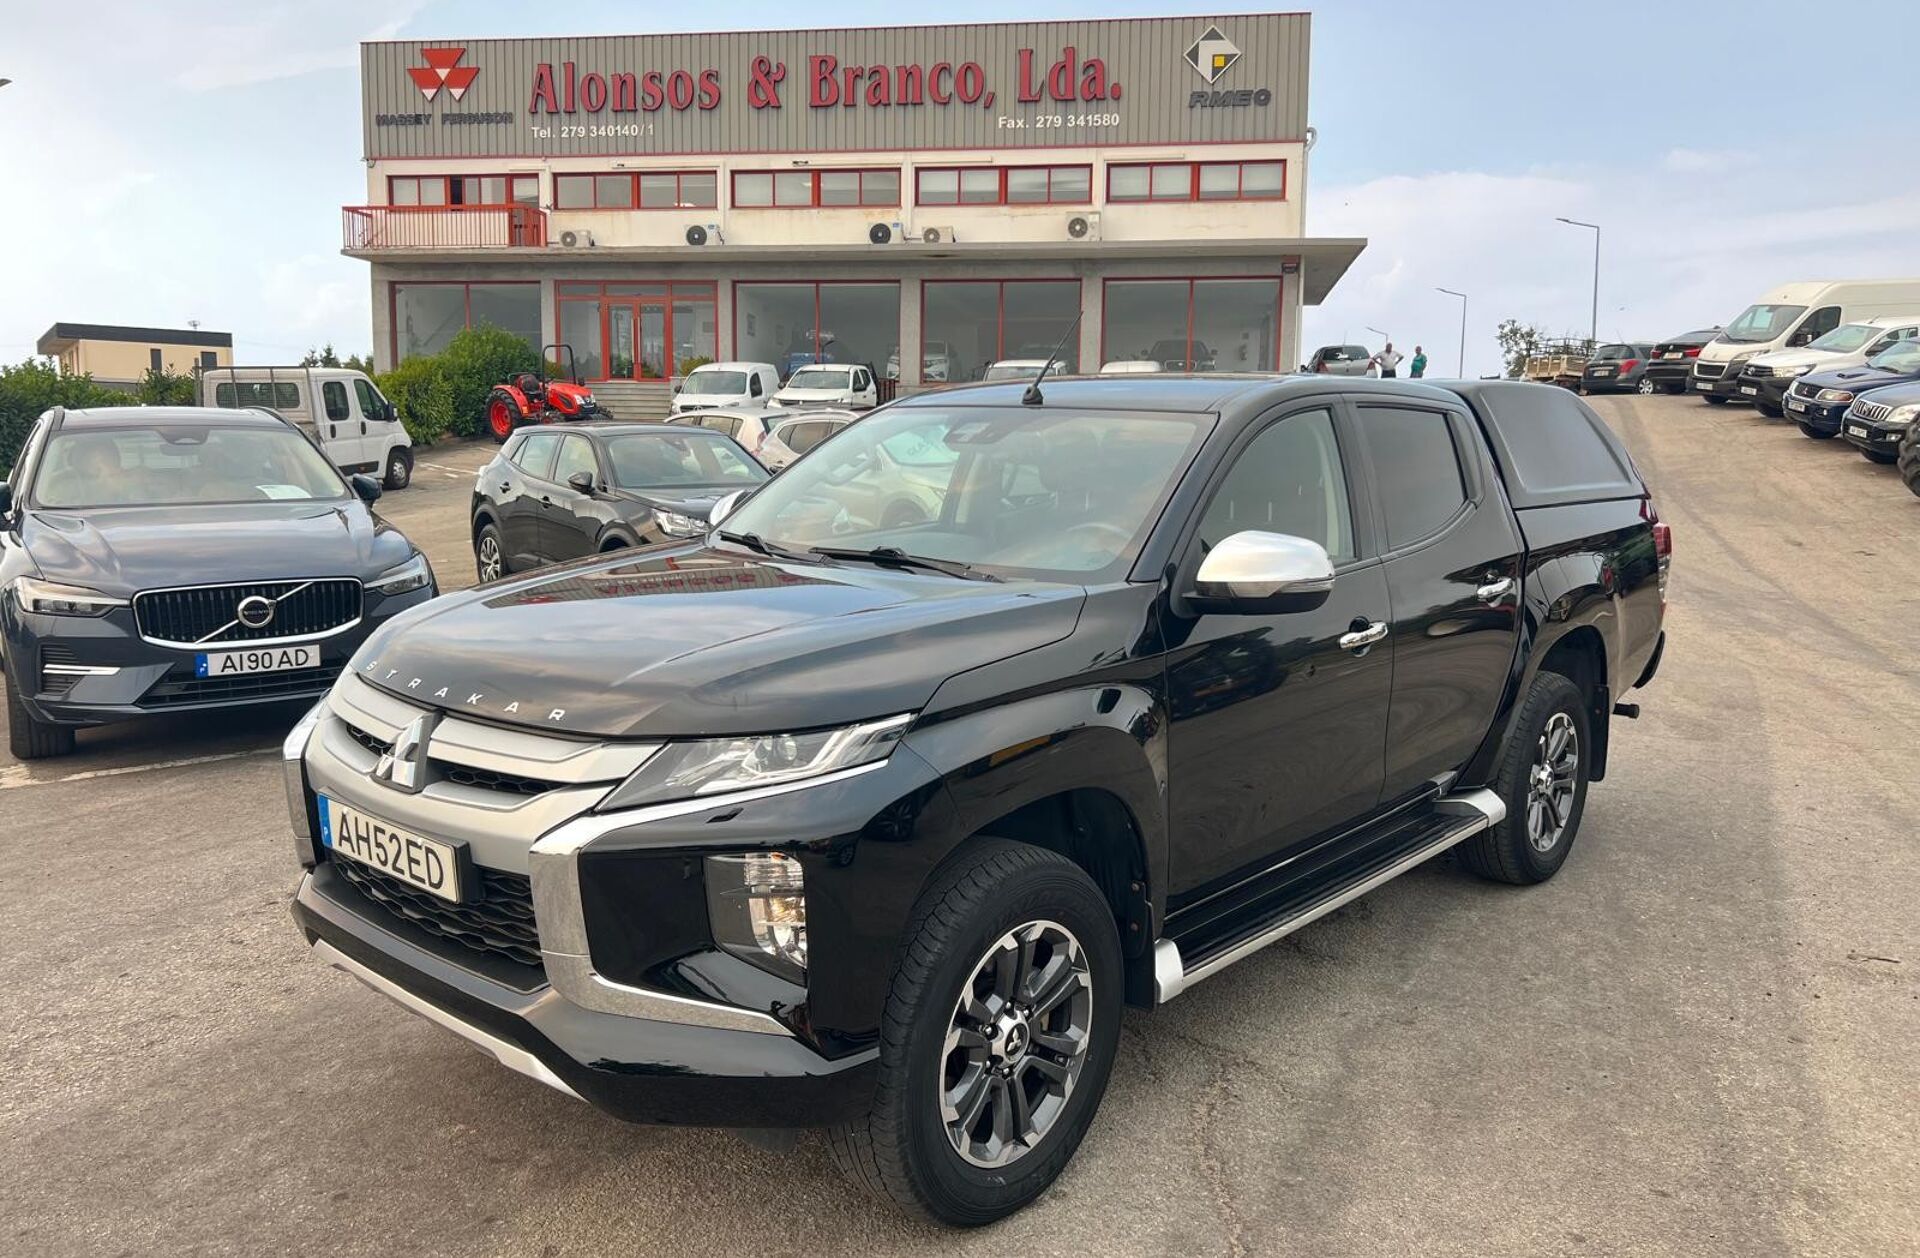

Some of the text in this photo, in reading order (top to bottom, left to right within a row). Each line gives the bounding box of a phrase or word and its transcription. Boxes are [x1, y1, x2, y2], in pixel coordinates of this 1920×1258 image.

[529, 46, 1121, 114] Alonsos & Branco, Lda.
[531, 126, 556, 138] Tel.
[561, 126, 586, 138] 279
[998, 113, 1120, 128] Fax. 279 341580
[365, 660, 565, 721] STRAKAR
[338, 812, 445, 890] AH52ED
